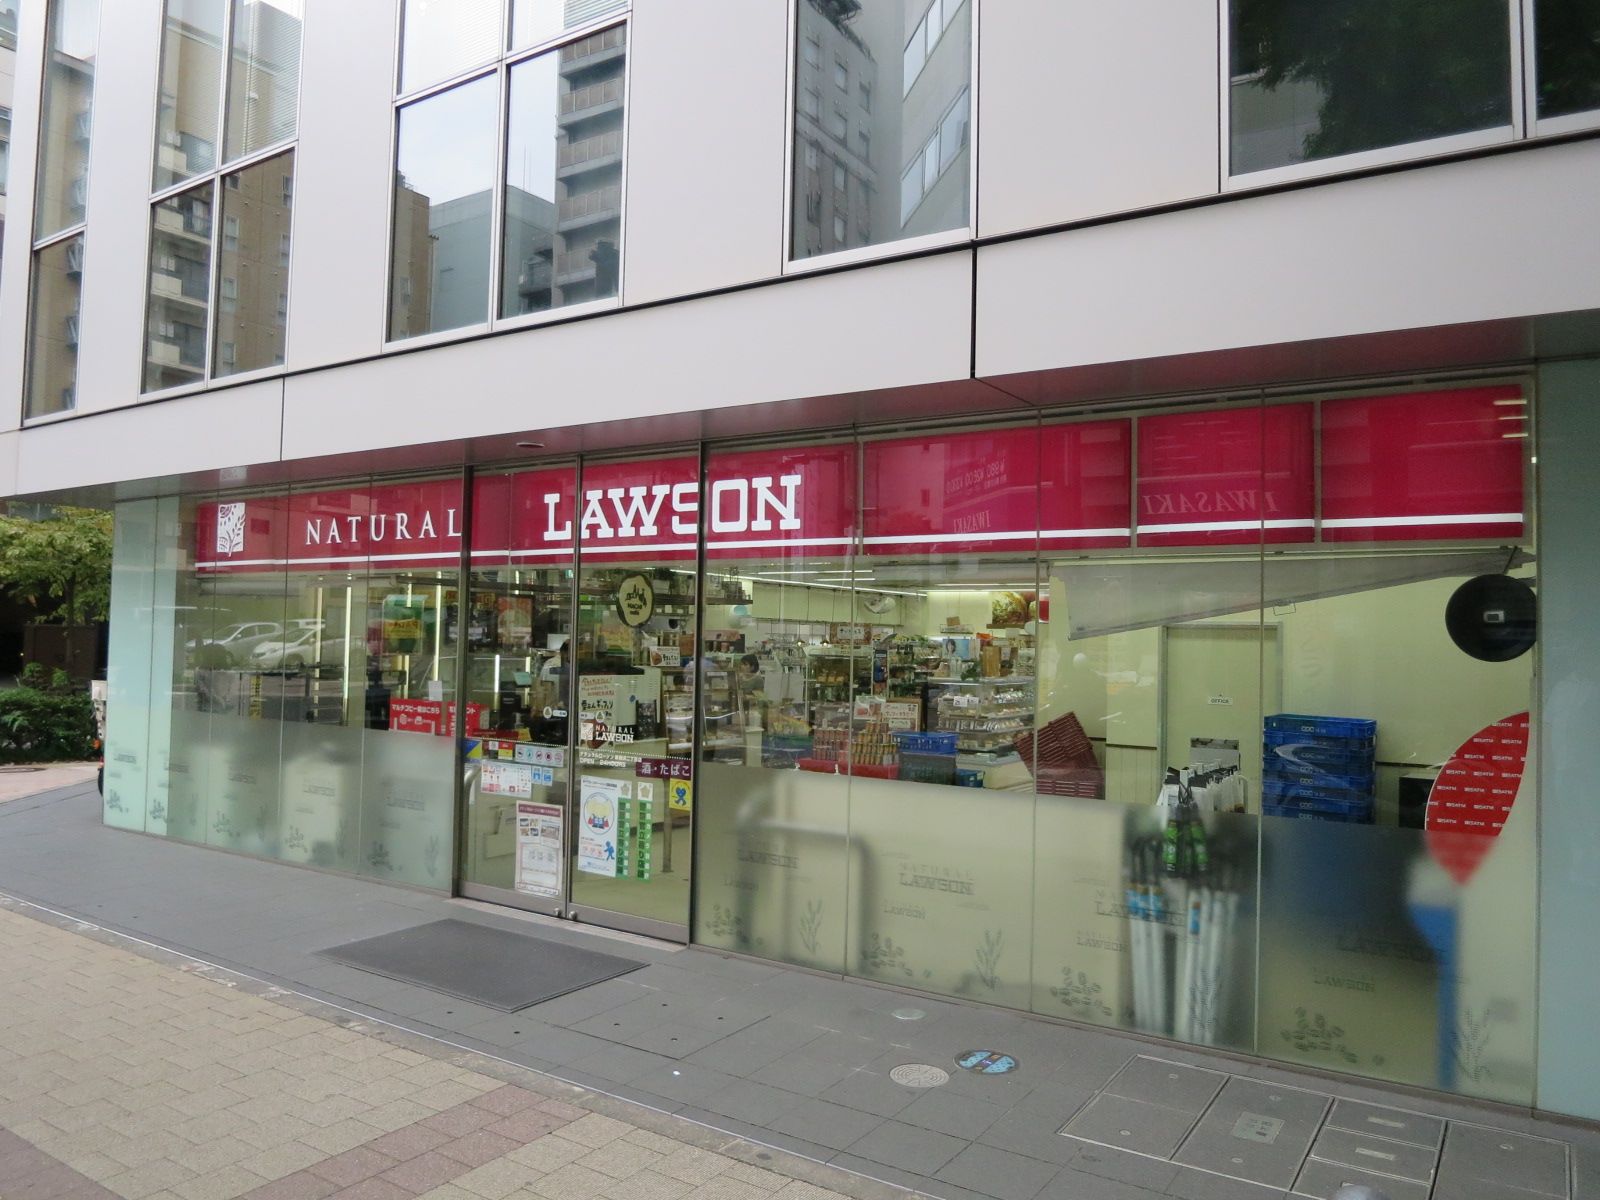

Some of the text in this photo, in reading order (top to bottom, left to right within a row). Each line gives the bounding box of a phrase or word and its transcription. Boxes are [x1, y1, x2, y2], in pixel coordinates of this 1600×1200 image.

[543, 475, 802, 541] LAWSON
[305, 509, 462, 545] NATURAL
[595, 732, 634, 743] LAWSON
[641, 762, 690, 776] 酒・たばこ
[898, 873, 975, 895] LAWSON
